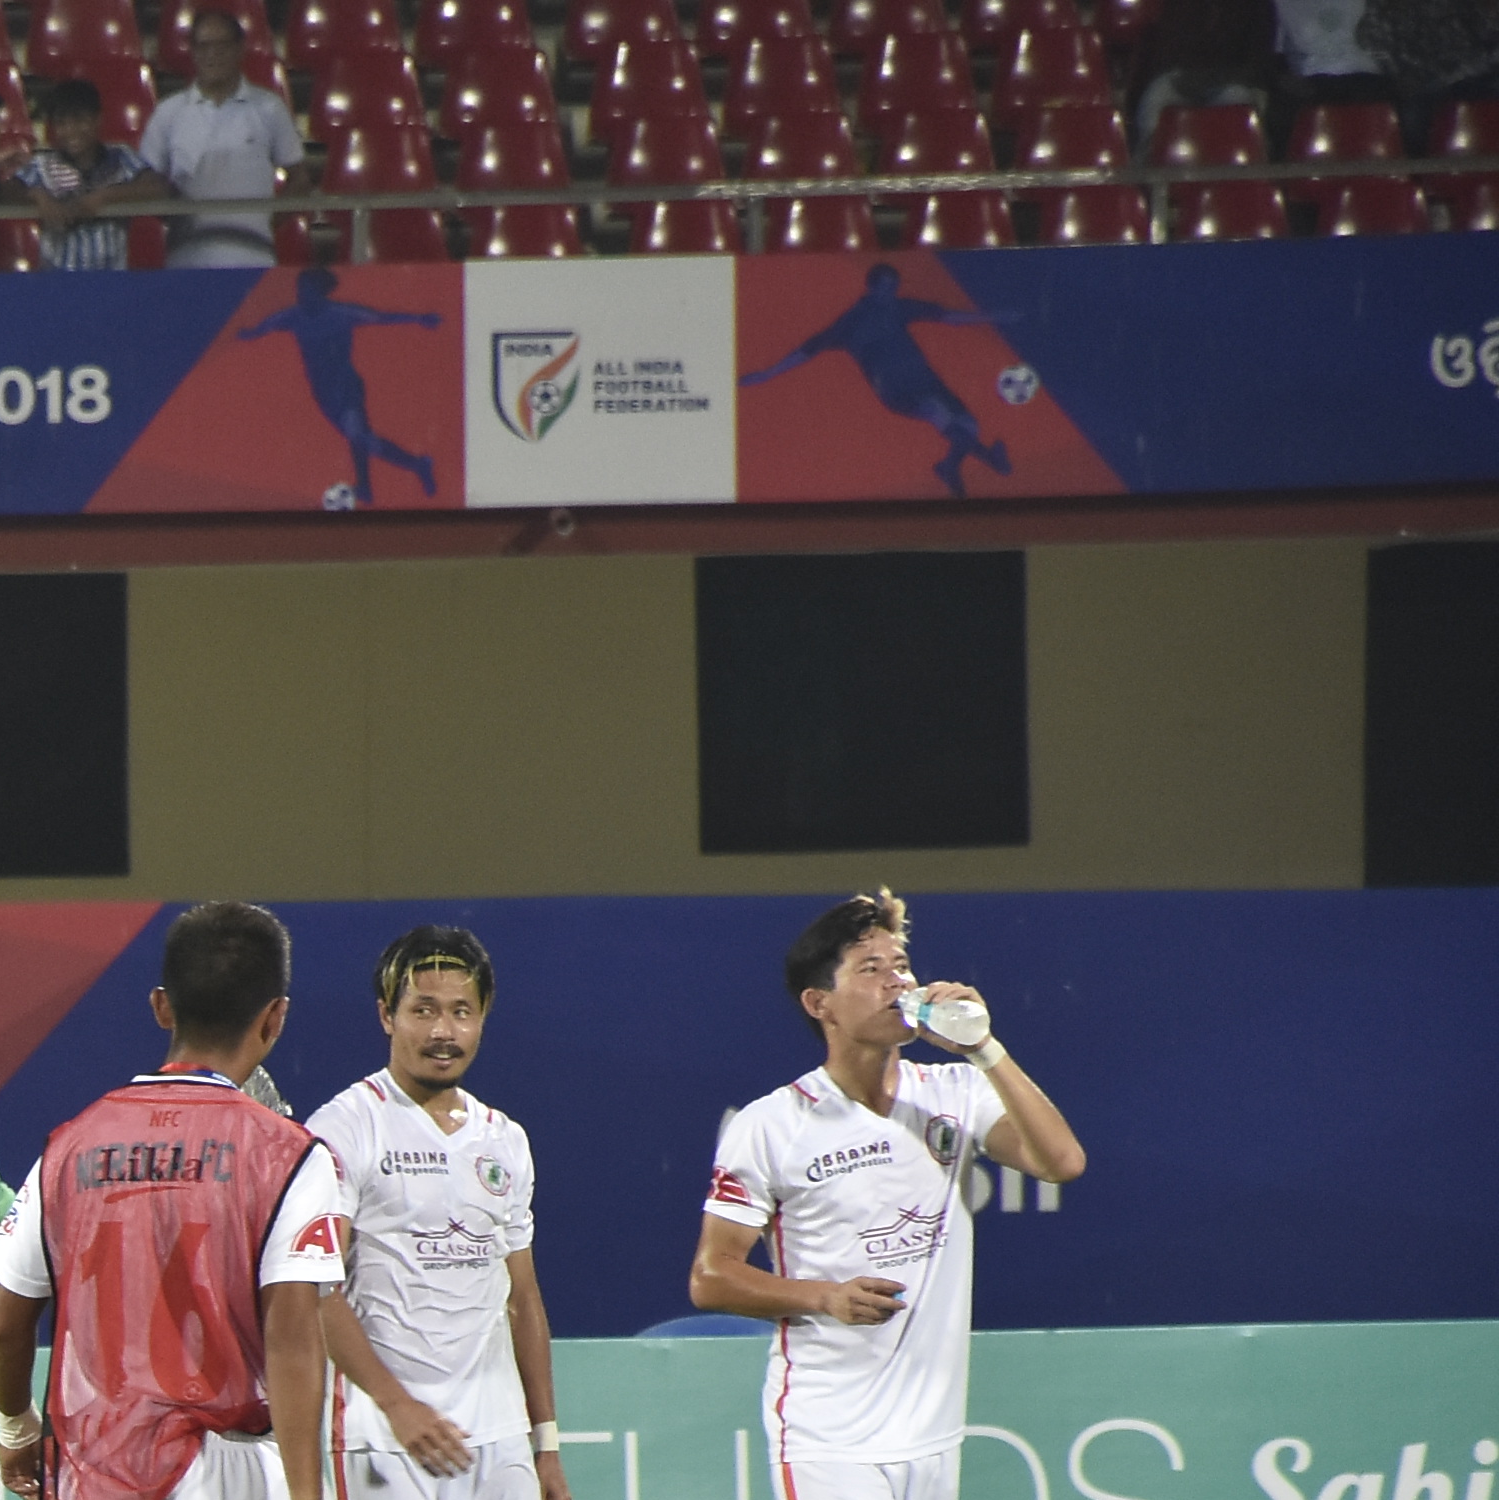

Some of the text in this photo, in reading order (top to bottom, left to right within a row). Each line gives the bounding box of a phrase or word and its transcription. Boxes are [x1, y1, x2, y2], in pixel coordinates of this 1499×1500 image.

[594, 361, 685, 376] ALL INDIA
[594, 380, 689, 395] FOOTBALL
[594, 399, 710, 413] FEDERATION
[150, 1110, 184, 1128] NFC
[201, 1138, 236, 1182] FC
[822, 1141, 891, 1167] BABINA
[866, 1228, 948, 1254] CLASS
[80, 1221, 229, 1400] 16
